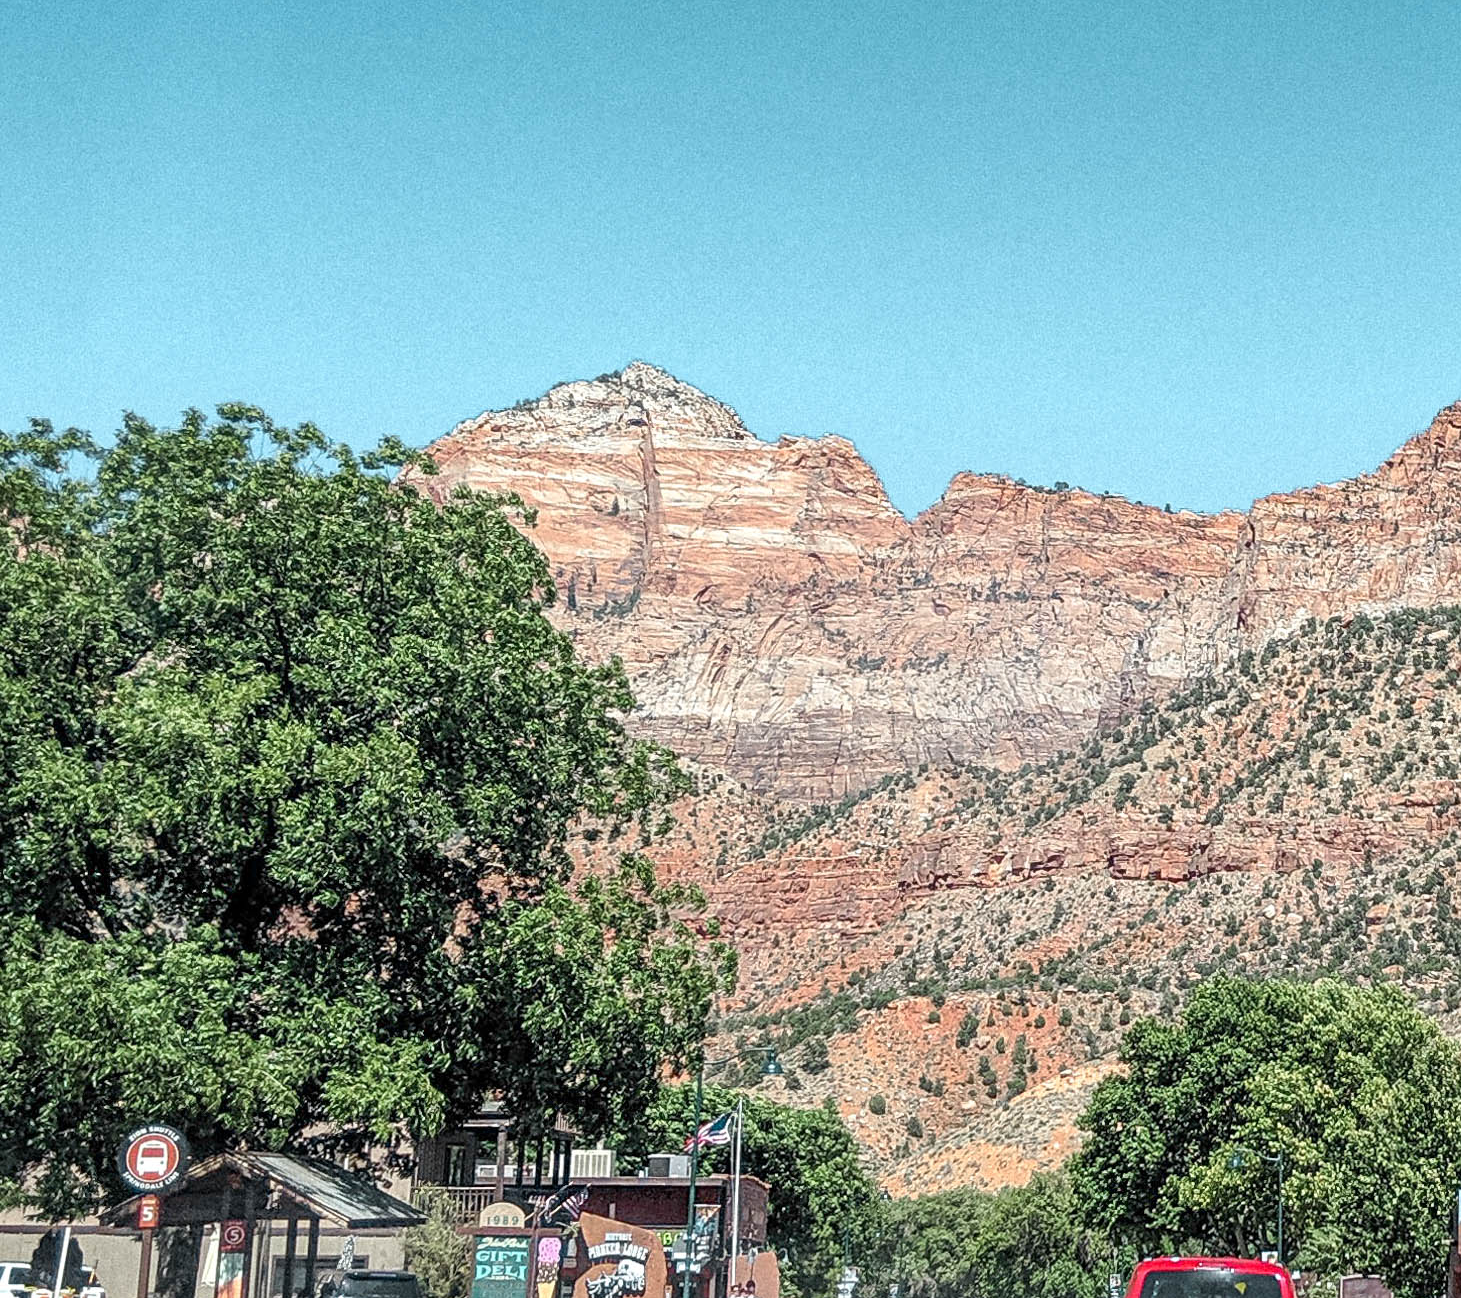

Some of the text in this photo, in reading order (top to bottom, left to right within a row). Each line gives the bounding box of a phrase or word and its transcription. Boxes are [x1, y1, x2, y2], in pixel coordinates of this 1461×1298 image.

[142, 1206, 154, 1222] 5
[486, 1215, 520, 1226] 1989
[475, 1250, 528, 1263] GIFT
[475, 1264, 528, 1281] DELI
